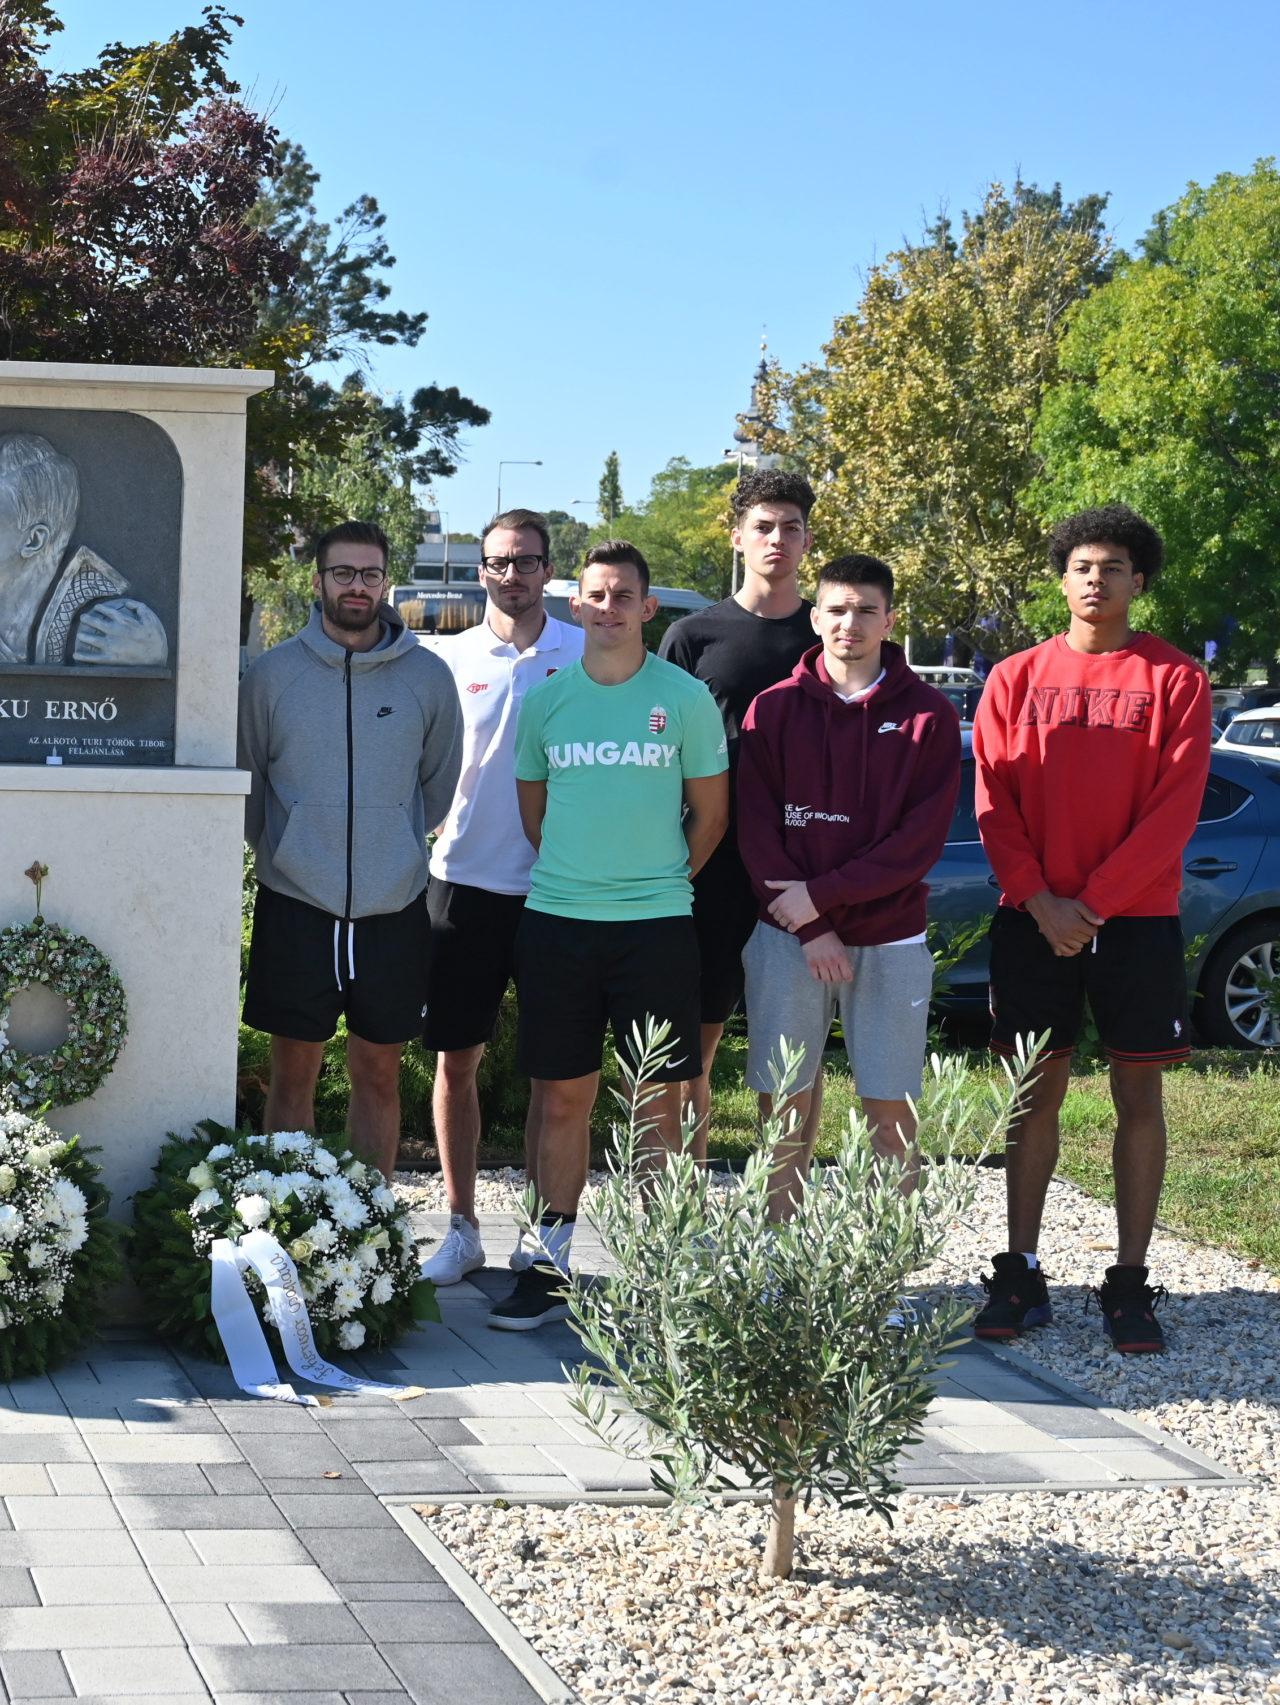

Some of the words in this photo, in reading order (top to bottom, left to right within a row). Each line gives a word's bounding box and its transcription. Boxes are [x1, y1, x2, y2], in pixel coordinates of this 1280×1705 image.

[417, 592, 463, 600] Mercedes-Benz
[45, 698, 118, 721] ERNŐ
[1023, 687, 1155, 733] NIKE
[29, 736, 40, 745] AZ
[42, 736, 77, 745] ALKOTÓ
[82, 738, 103, 746] TURI
[107, 737, 135, 747] TÖRÖK
[140, 740, 166, 748] TIBOR
[804, 812, 813, 820] OF
